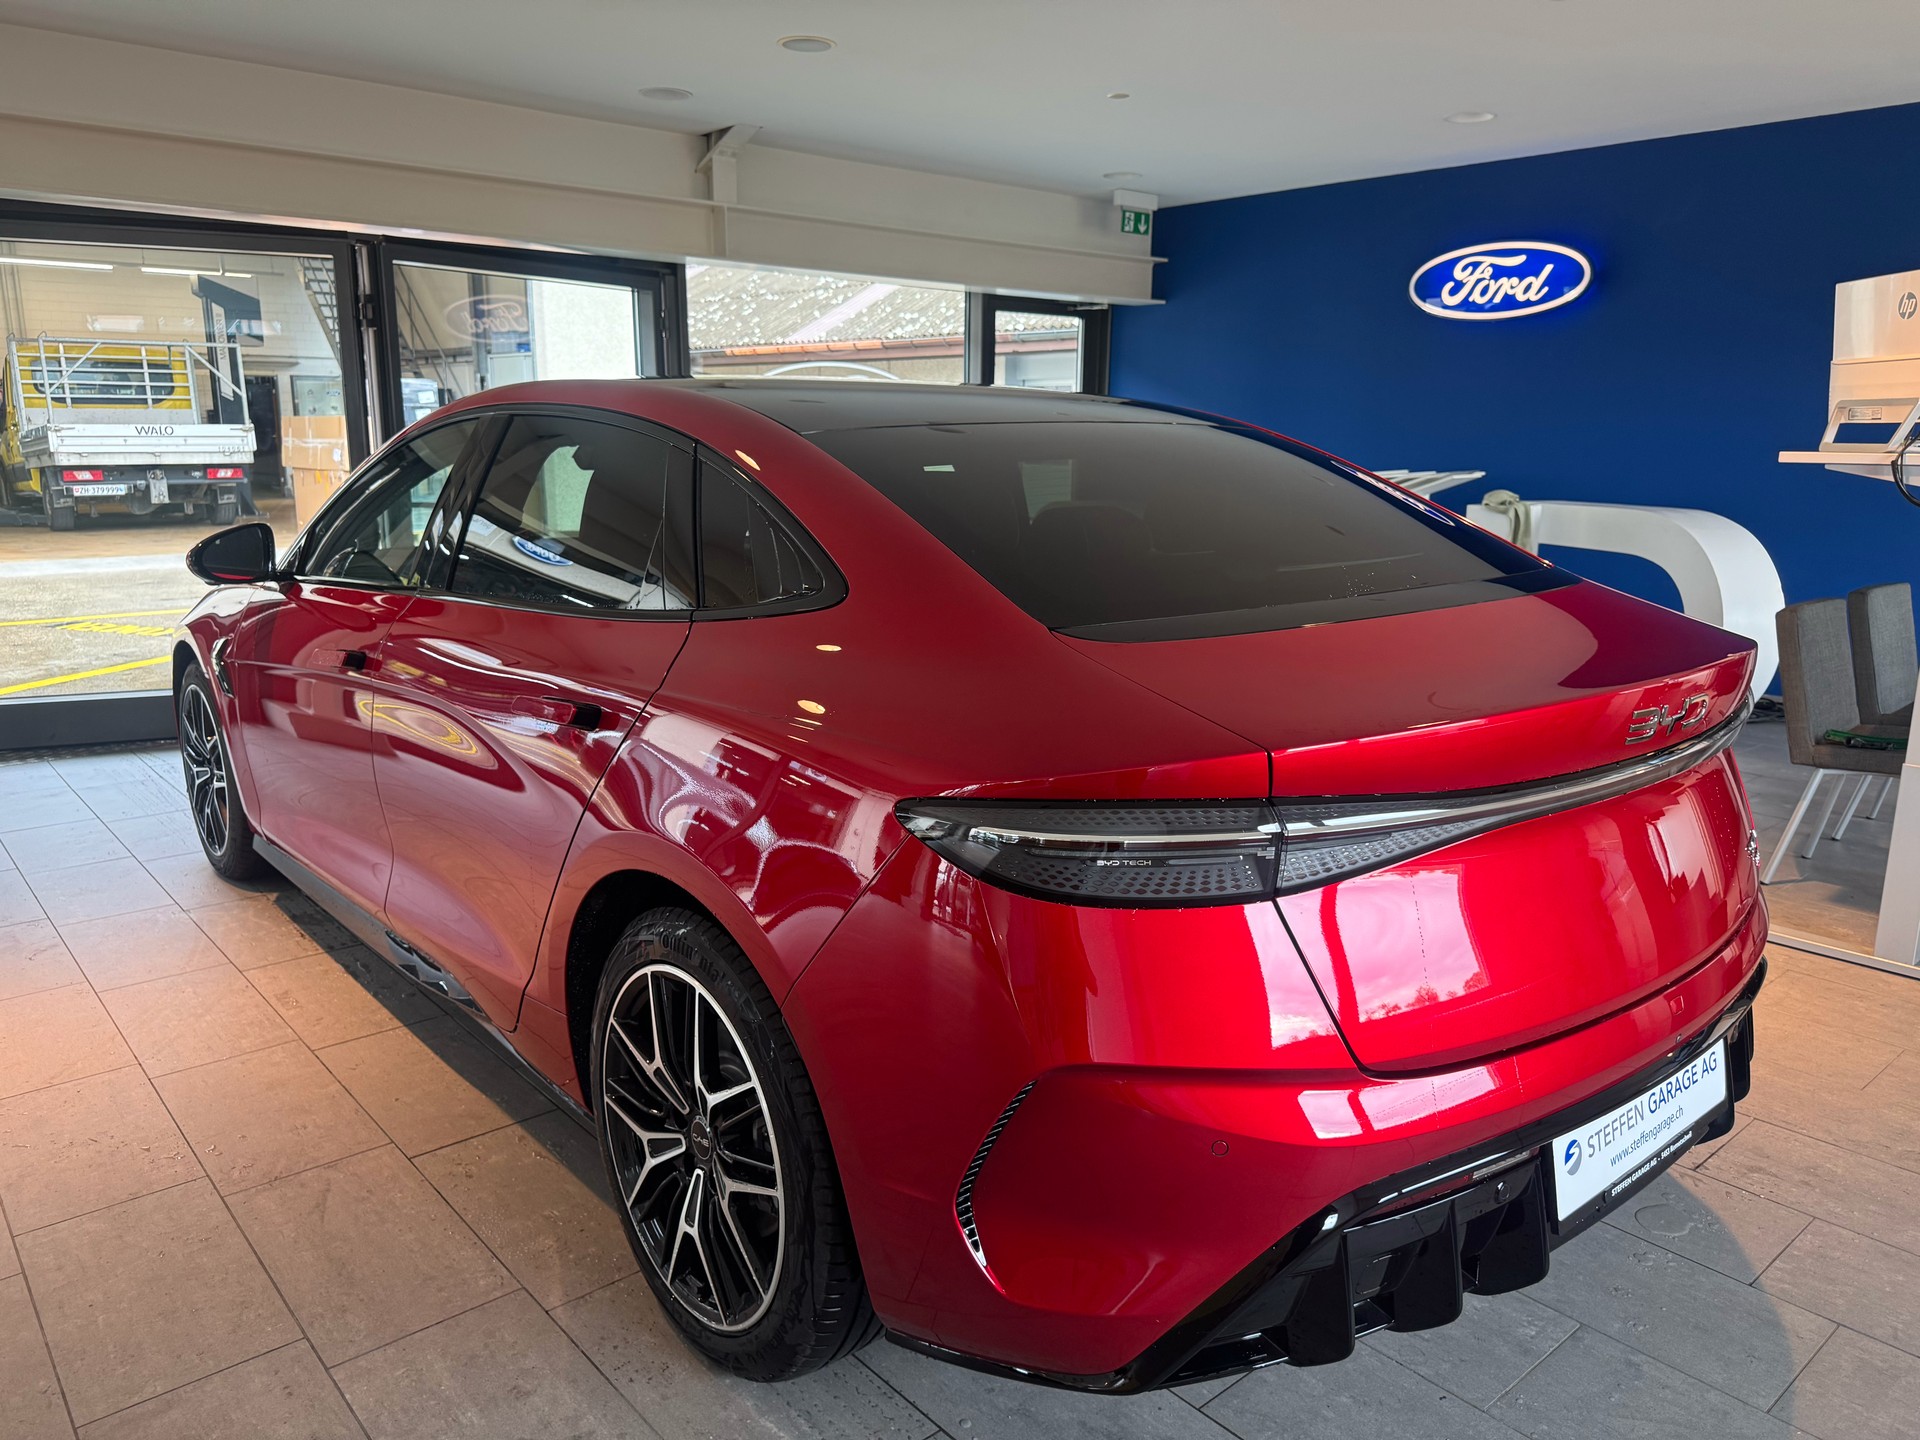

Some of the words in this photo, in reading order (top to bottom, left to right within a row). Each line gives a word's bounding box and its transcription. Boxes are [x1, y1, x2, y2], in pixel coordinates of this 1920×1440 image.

[1441, 254, 1554, 306] Ford
[1899, 292, 1916, 320] hp
[134, 425, 174, 436] WALO
[1625, 692, 1709, 745] BYD
[1587, 1100, 1645, 1158] STEFFEN
[1648, 1063, 1698, 1114] GARAGE
[1701, 1051, 1718, 1079] AG
[1610, 1105, 1684, 1168] www.steffengarage.ch
[1611, 1175, 1632, 1197] STEFFEN
[1631, 1162, 1651, 1181] GARAGE
[1650, 1157, 1657, 1167] AG
